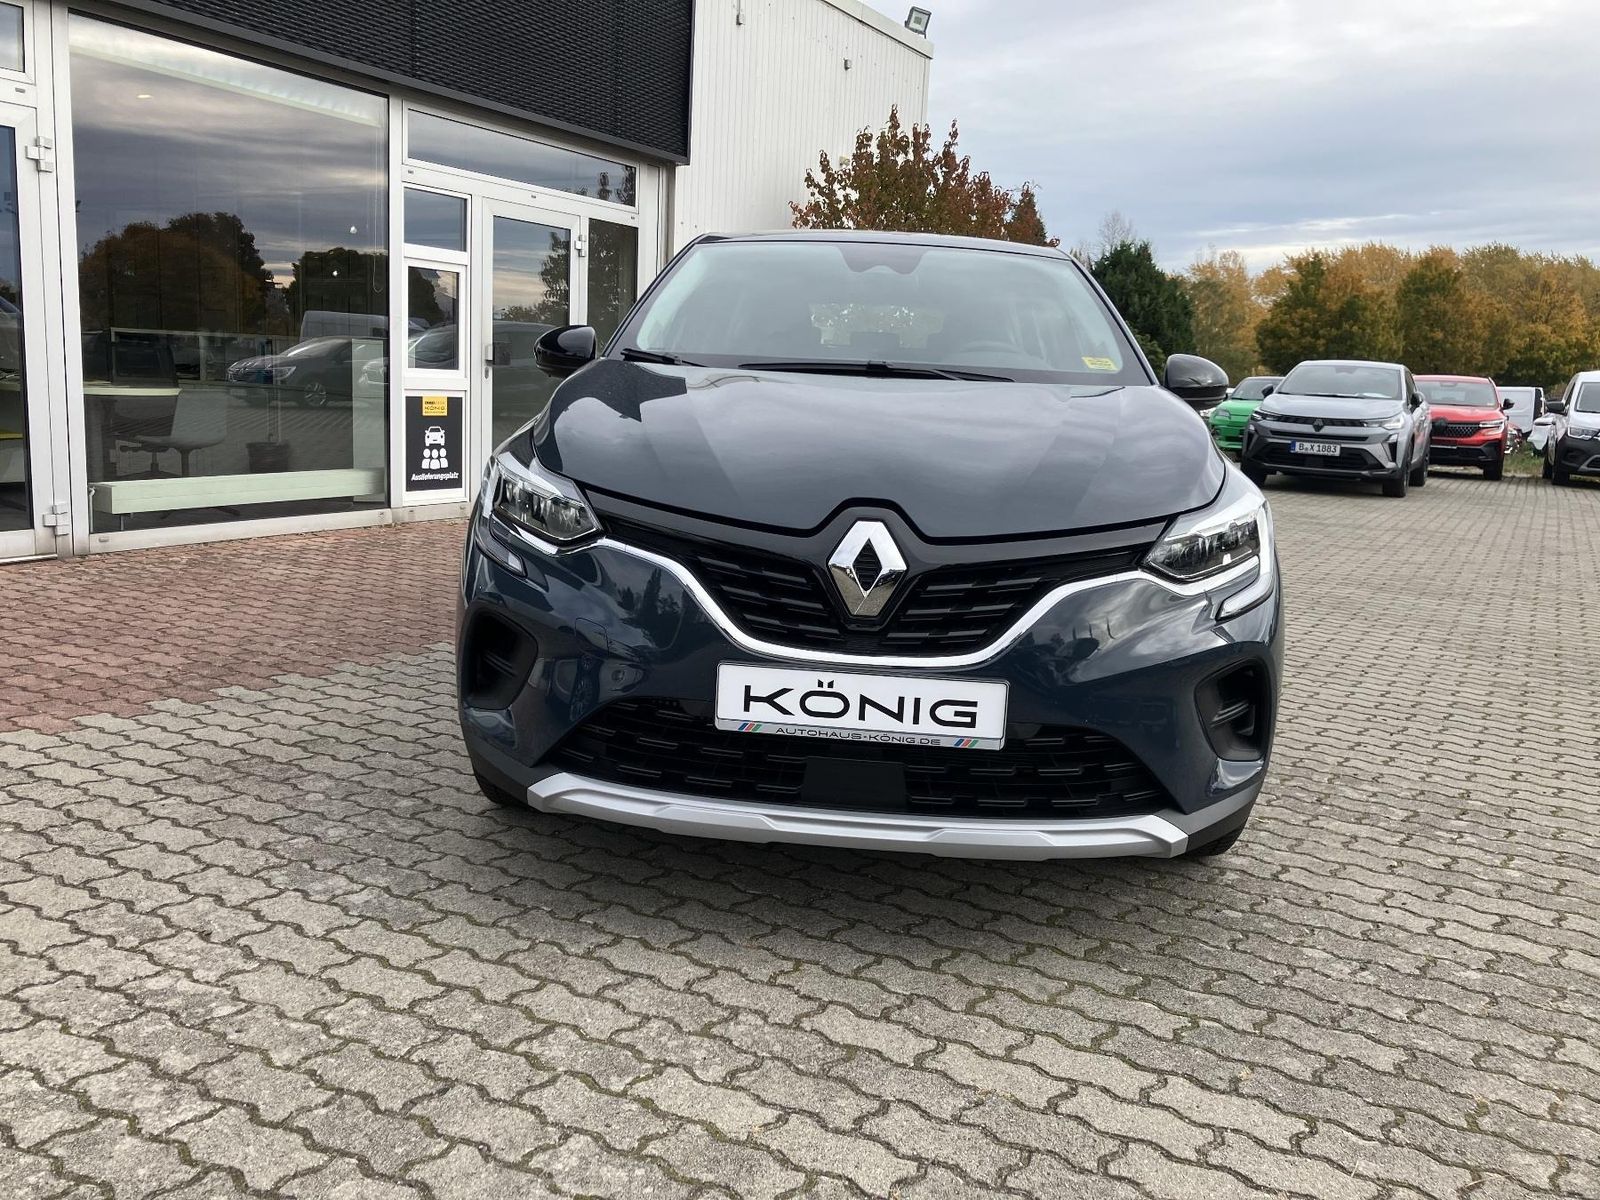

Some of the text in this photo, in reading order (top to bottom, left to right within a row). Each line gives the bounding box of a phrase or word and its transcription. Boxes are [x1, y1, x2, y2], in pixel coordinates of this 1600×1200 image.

[1317, 445, 1337, 453] 1883
[411, 472, 459, 481] Auslieferungsplatz
[743, 679, 978, 728] KÖNIG
